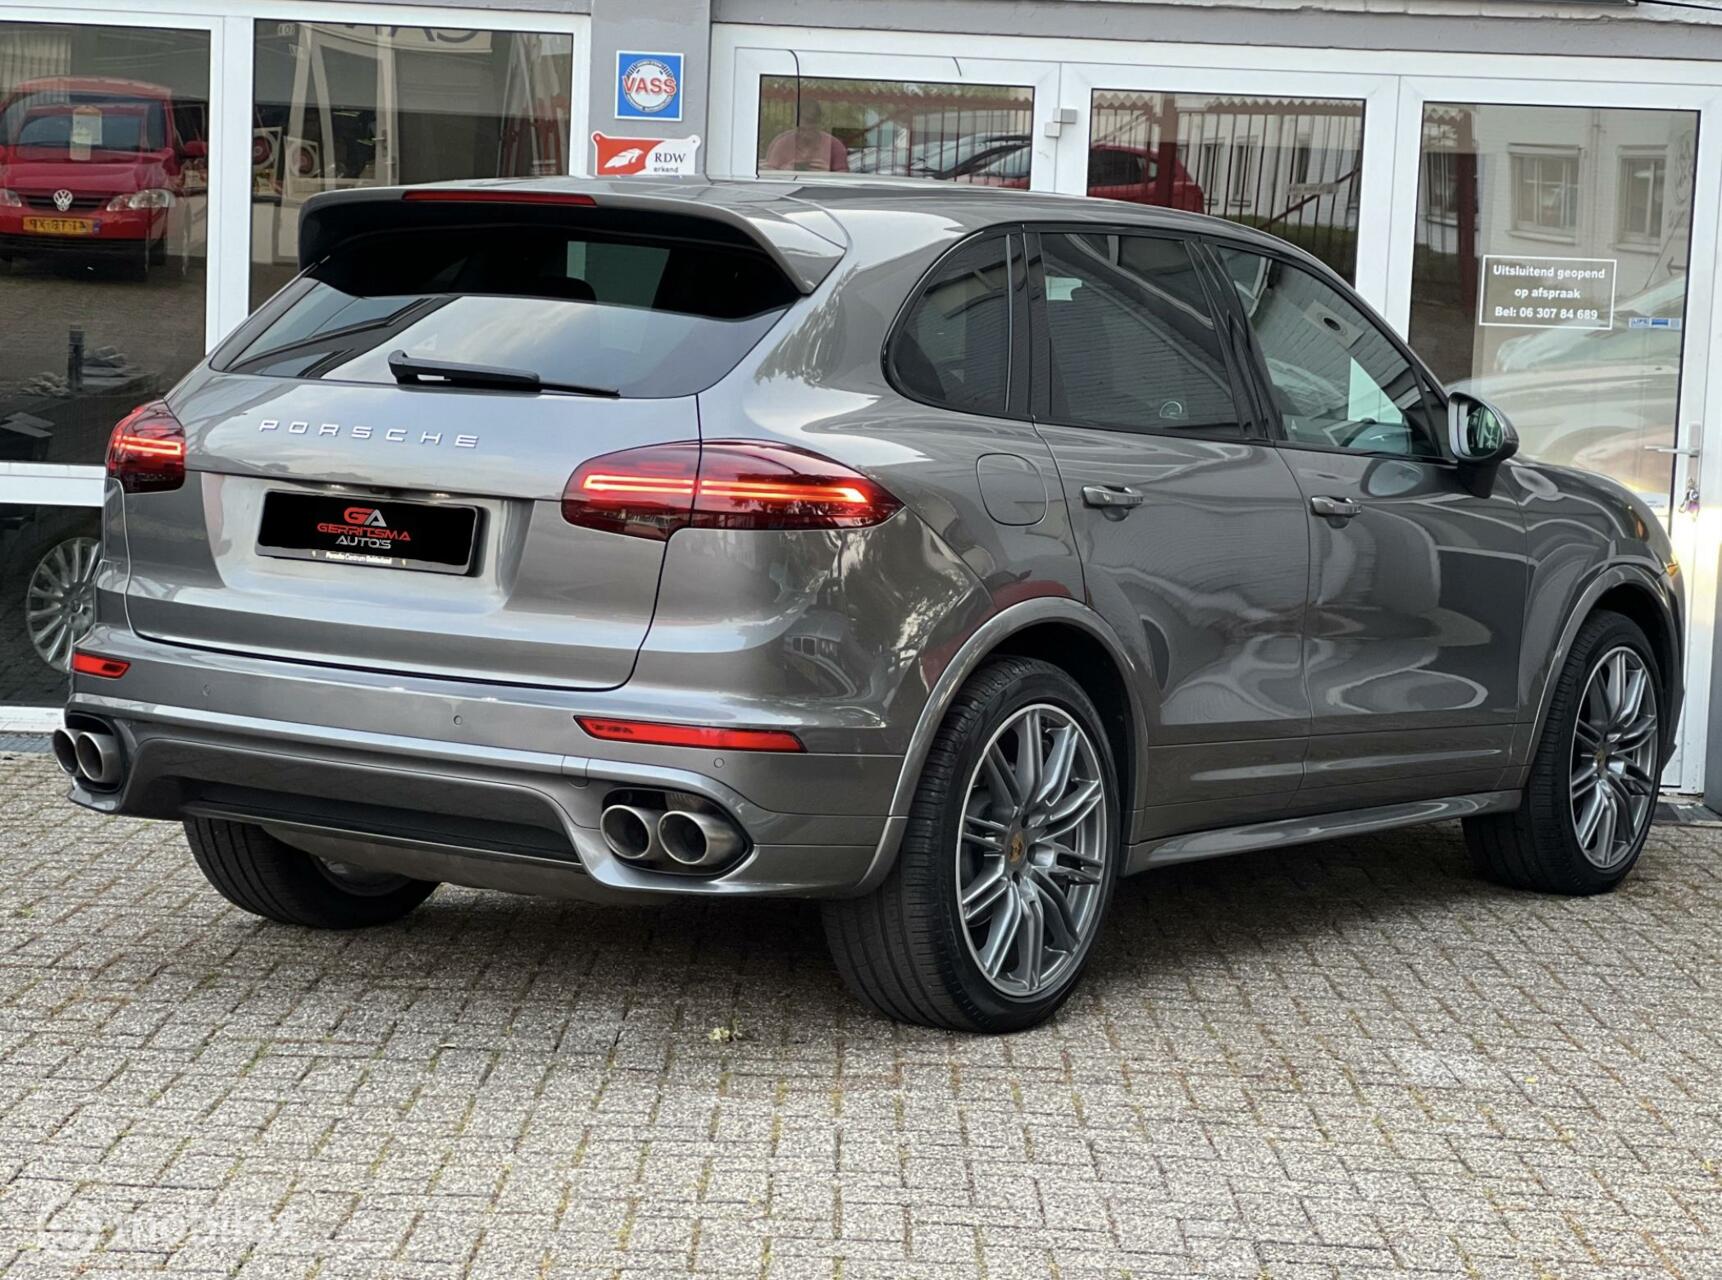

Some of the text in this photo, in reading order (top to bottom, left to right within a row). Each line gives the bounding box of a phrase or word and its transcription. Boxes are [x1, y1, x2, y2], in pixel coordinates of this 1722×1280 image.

[623, 76, 677, 96] VASS
[655, 152, 686, 163] RDW
[1493, 264, 1606, 280] Uitsluitend geopend
[1514, 287, 1581, 300] op afspraak
[1495, 306, 1599, 320] Bel: 06 307 84 689
[258, 419, 479, 449] PORSCHE
[343, 507, 387, 528] GA
[317, 522, 412, 541] GERRITSMA
[335, 535, 392, 550] AUTO'S
